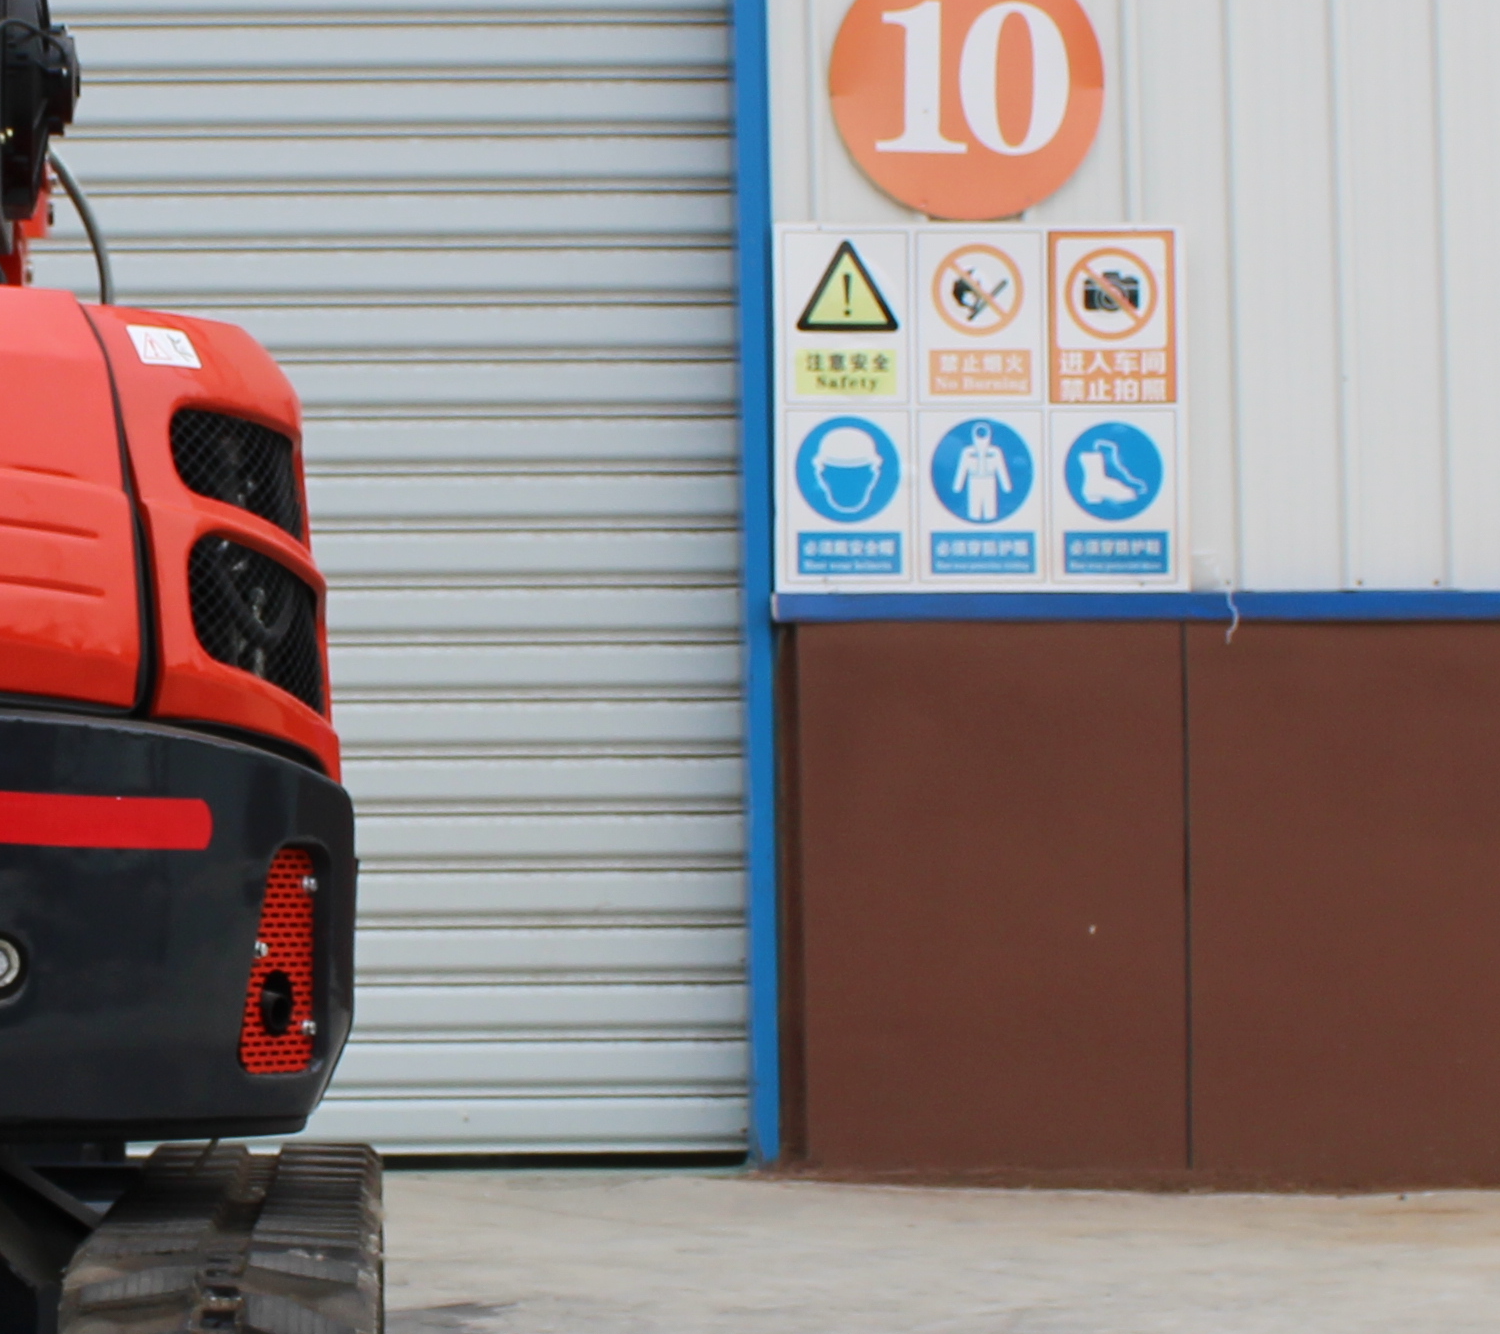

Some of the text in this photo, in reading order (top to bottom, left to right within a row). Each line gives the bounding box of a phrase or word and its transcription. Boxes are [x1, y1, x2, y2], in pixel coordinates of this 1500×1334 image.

[805, 353, 890, 372] 注意安全
[1059, 351, 1167, 375] 进入车间
[816, 374, 877, 392] Safety
[1059, 377, 1167, 402] 禁止拍照
